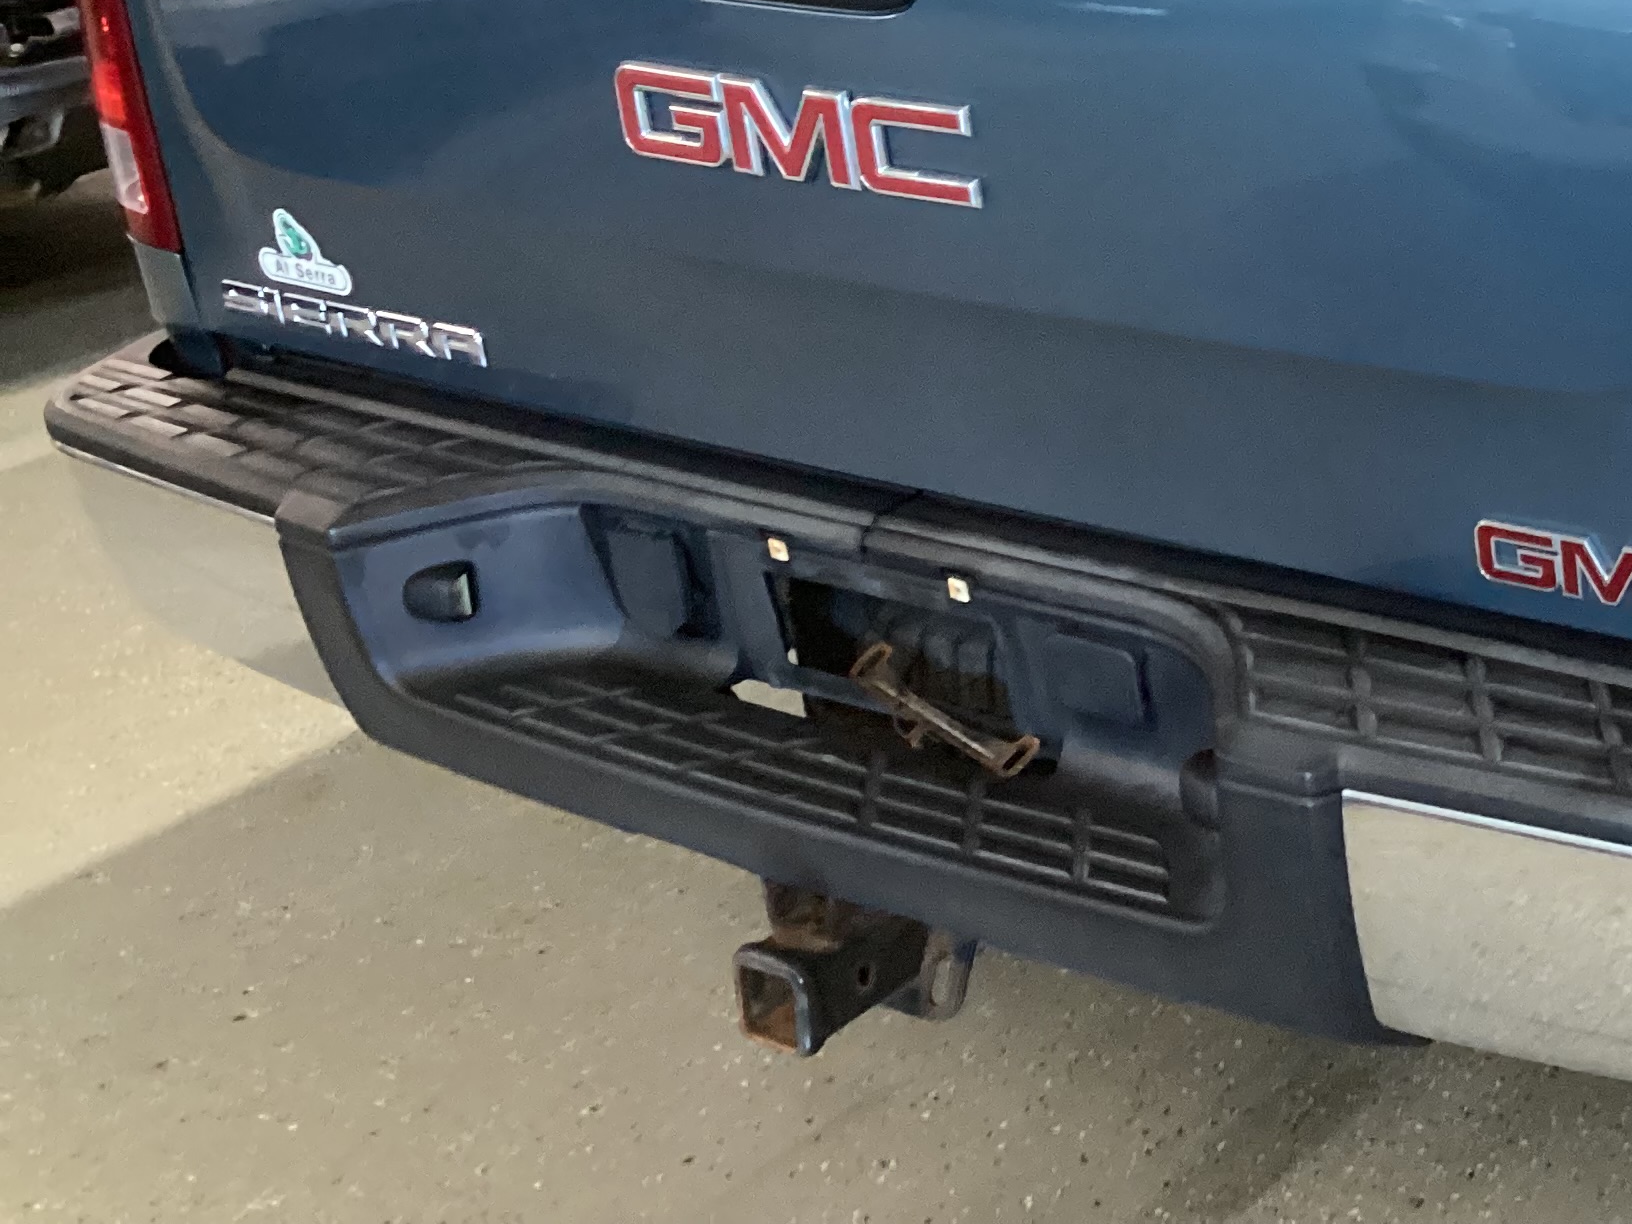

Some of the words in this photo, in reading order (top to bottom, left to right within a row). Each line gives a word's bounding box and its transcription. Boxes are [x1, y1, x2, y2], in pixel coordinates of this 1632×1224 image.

[614, 60, 983, 209] GMC
[295, 262, 337, 286] Serra
[221, 278, 488, 369] SIERRA
